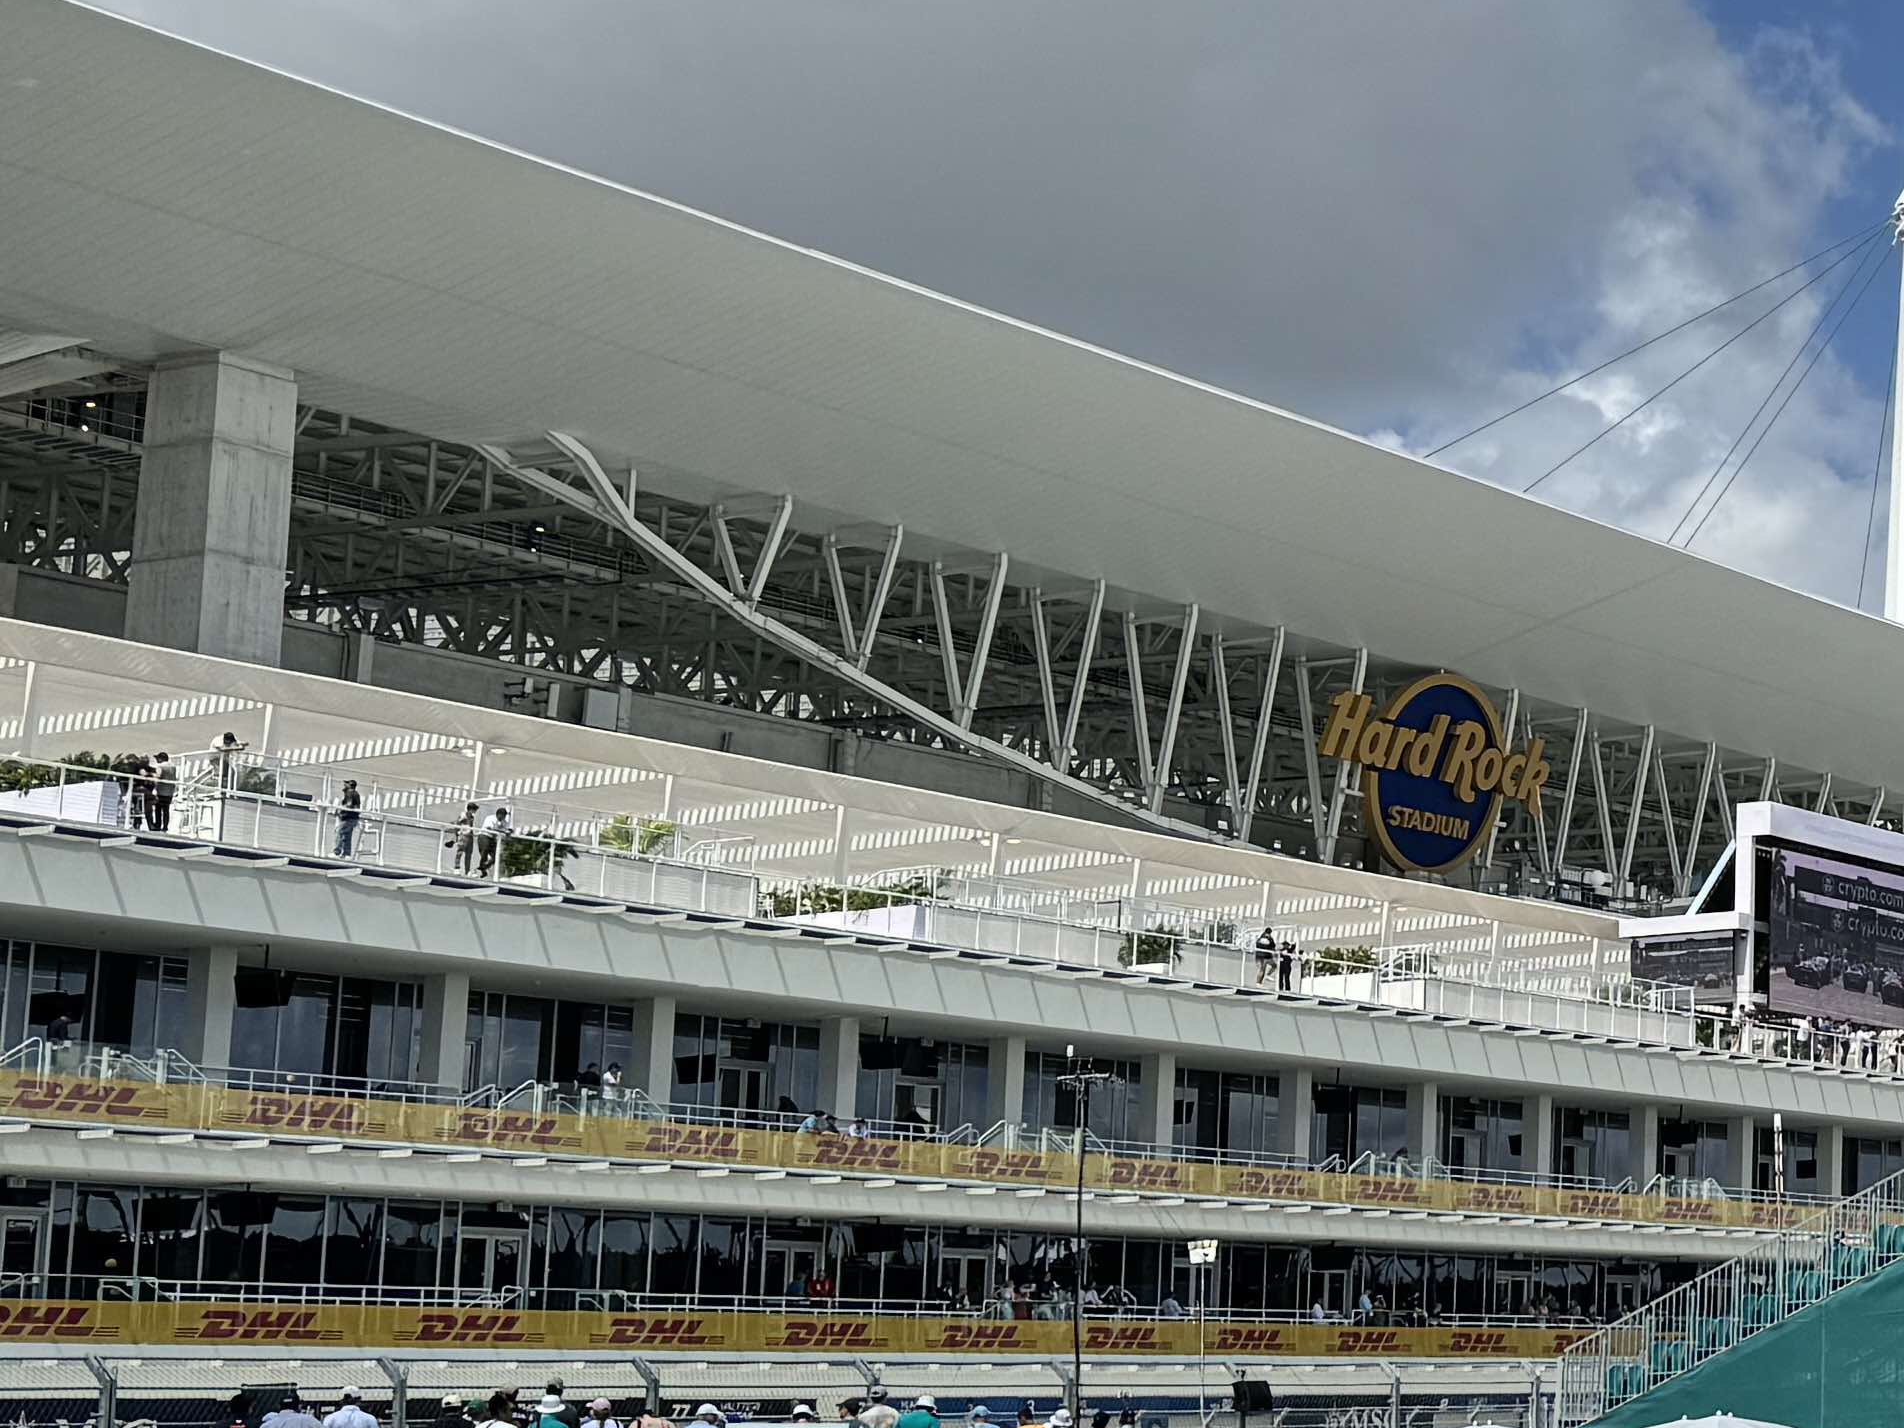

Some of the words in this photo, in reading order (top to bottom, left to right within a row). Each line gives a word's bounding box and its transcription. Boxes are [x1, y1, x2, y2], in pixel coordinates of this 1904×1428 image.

[1322, 691, 1451, 778] Hard
[1440, 720, 1550, 817] Rock
[1388, 805, 1470, 840] STADIUM
[1839, 882, 1904, 908] crypto.com
[12, 1079, 145, 1117] DHL
[454, 1113, 563, 1146] DHL
[643, 1127, 741, 1159] DHL
[814, 1140, 901, 1169] DHL
[970, 1152, 1048, 1179] DHL
[1108, 1161, 1184, 1190] DHL
[199, 1310, 322, 1340] DHL
[413, 1314, 526, 1342] DHL
[607, 1318, 704, 1346] DHL
[781, 1322, 876, 1347] DHL
[940, 1325, 1024, 1348] DHL
[1084, 1327, 1158, 1349] DHL
[1216, 1329, 1282, 1351] DHL
[1336, 1332, 1402, 1352] DHL
[1449, 1333, 1508, 1353] DHL
[671, 1403, 692, 1418] 77
